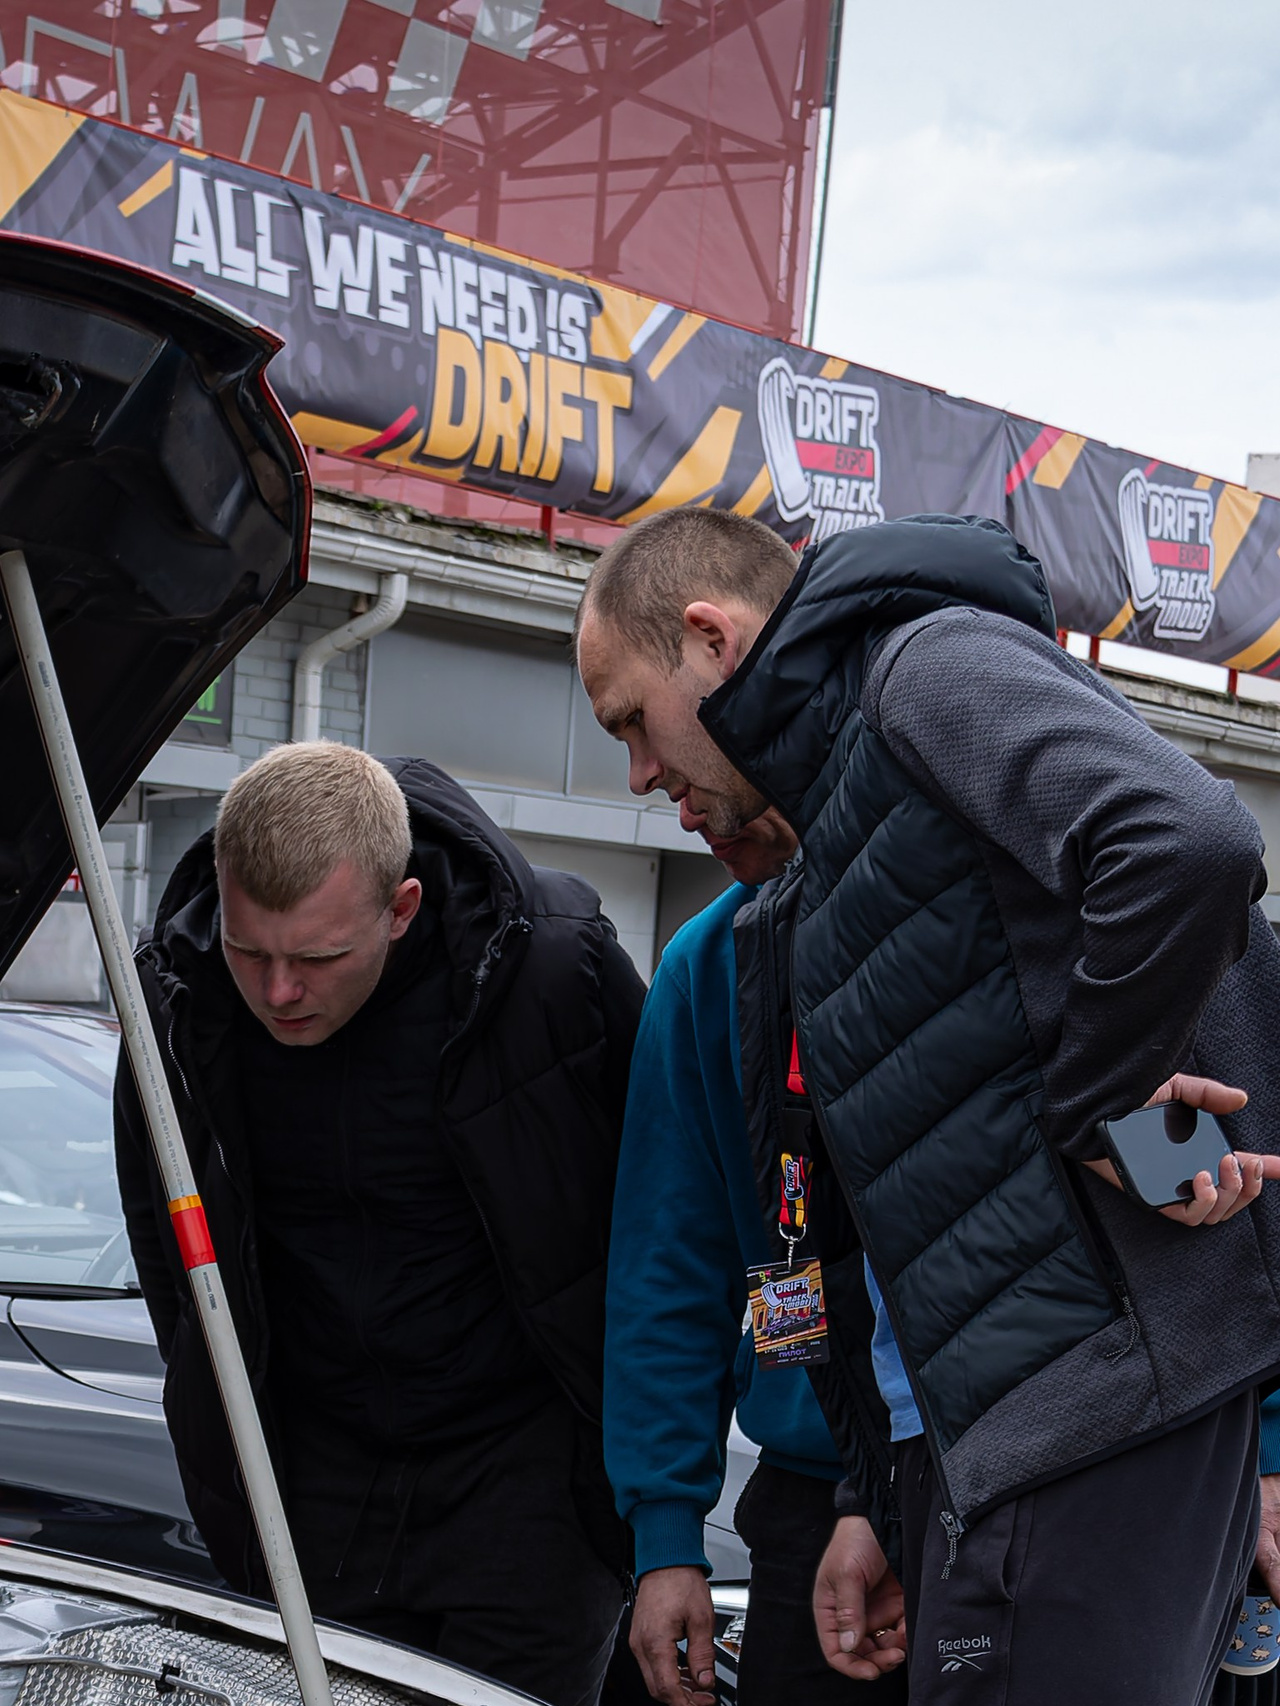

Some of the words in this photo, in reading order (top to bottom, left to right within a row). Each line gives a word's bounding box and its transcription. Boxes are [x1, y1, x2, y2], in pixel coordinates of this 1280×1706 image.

[172, 167, 298, 297] ALL
[302, 206, 412, 328] WE
[417, 244, 542, 361] NEED
[546, 287, 590, 363] IS
[422, 328, 632, 494] DRIFT
[796, 387, 873, 447] DRIFT
[835, 449, 866, 473] EXPO
[812, 475, 874, 512] TRACK
[1148, 494, 1209, 543] DRIFT
[1178, 545, 1203, 566] EXPO
[1161, 571, 1208, 601] TRACK
[1161, 601, 1210, 630] MODE
[776, 1280, 807, 1294] DRIFT
[937, 1634, 992, 1654] Reebok
